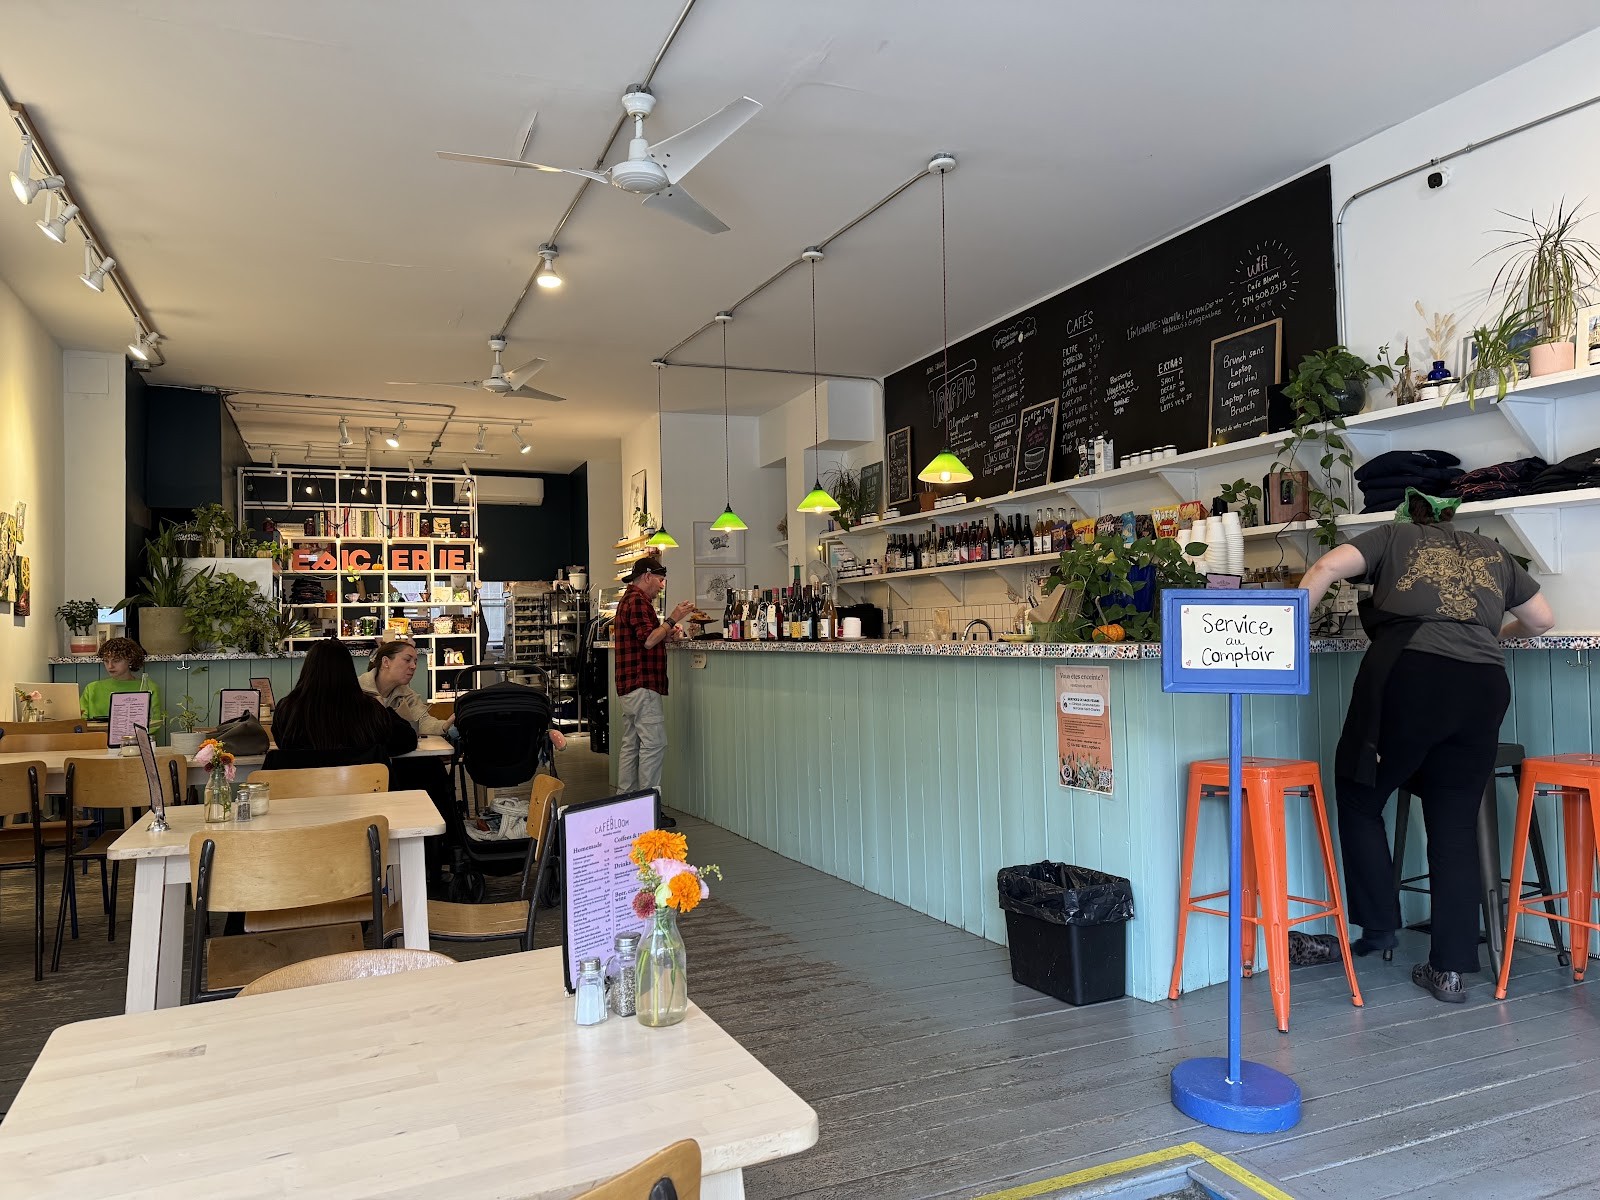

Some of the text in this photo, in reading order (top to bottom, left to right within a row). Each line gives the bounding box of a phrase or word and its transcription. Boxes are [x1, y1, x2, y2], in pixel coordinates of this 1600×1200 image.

[1242, 280, 1287, 307] 514 508 2313
[1066, 310, 1093, 335] CAFÉS
[1158, 356, 1183, 374] EXTRAS
[1223, 345, 1265, 369] Brunch sans
[1230, 364, 1252, 378] Laptop
[1230, 400, 1255, 417] Brunch
[1202, 612, 1273, 636] Service
[1225, 636, 1246, 646] au
[1201, 646, 1275, 667] Comptoir
[573, 842, 602, 854] Homemade
[614, 861, 632, 869] Drinks
